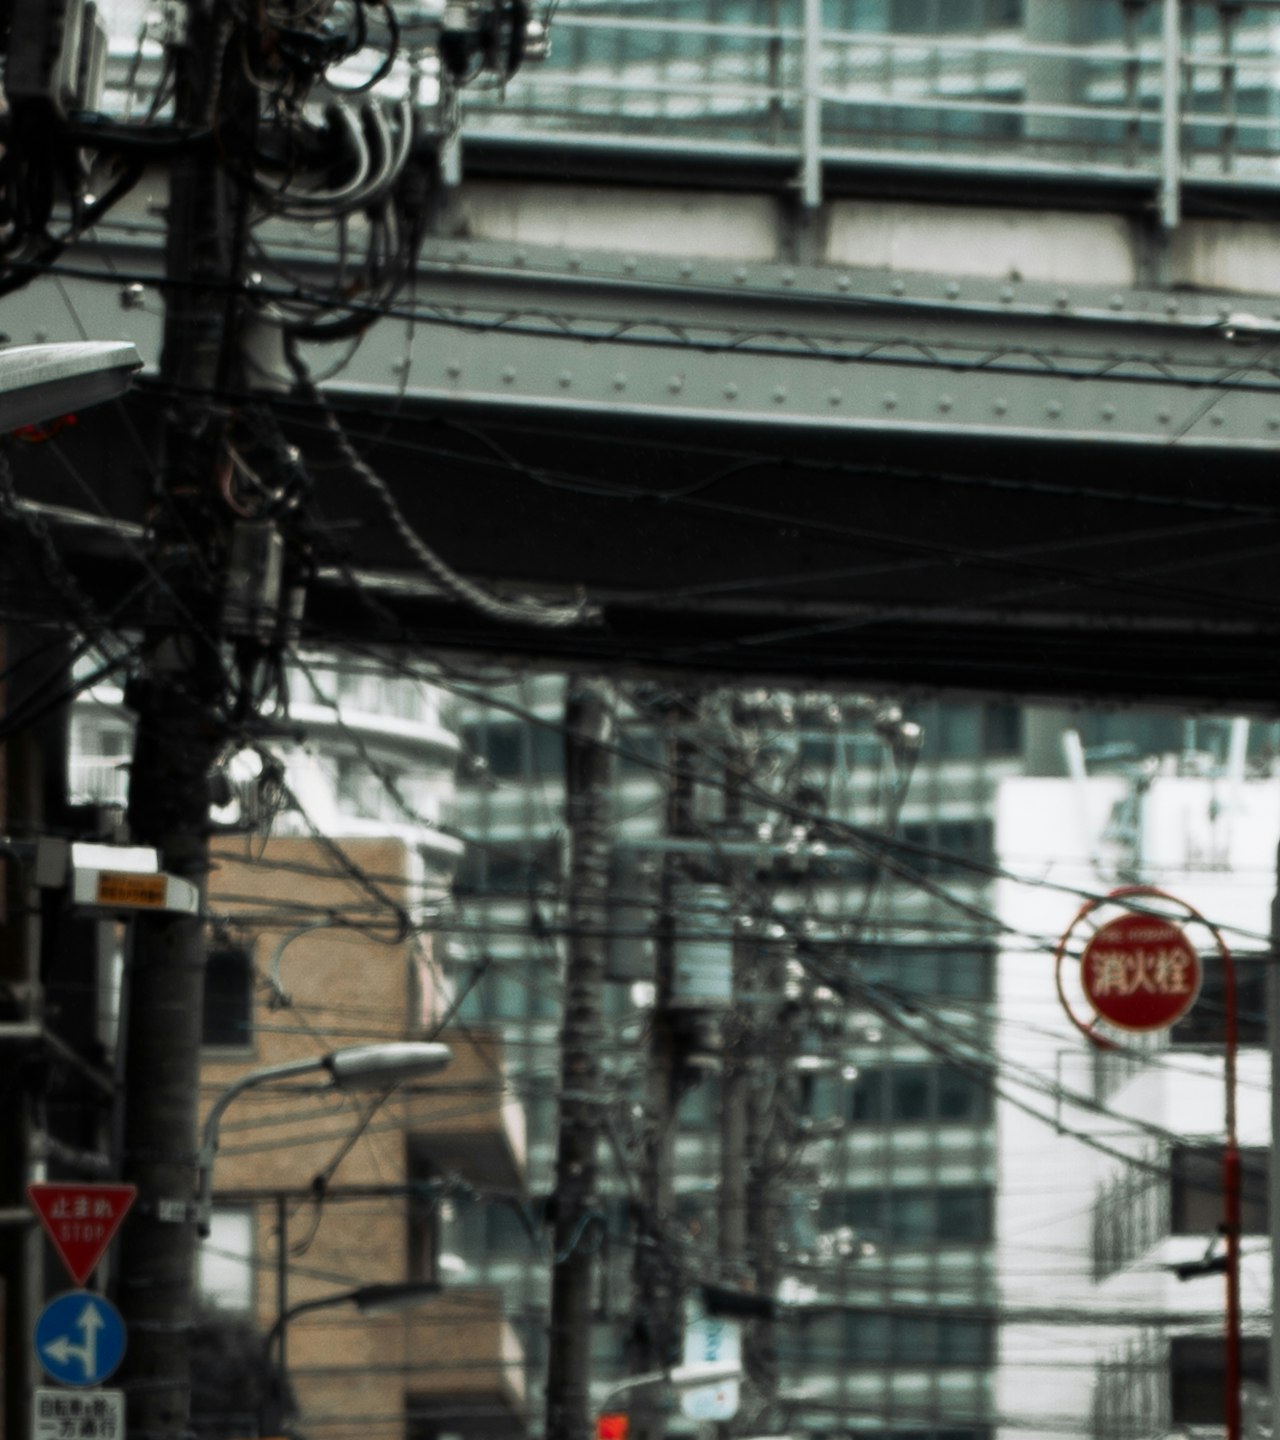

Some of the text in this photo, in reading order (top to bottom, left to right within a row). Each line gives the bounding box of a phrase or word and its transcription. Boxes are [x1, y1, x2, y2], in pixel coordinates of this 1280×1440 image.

[1093, 947, 1190, 997] 消火栓
[49, 1194, 114, 1220] 止まれ
[59, 1223, 106, 1244] STOP
[39, 1418, 117, 1439] 一方通行
